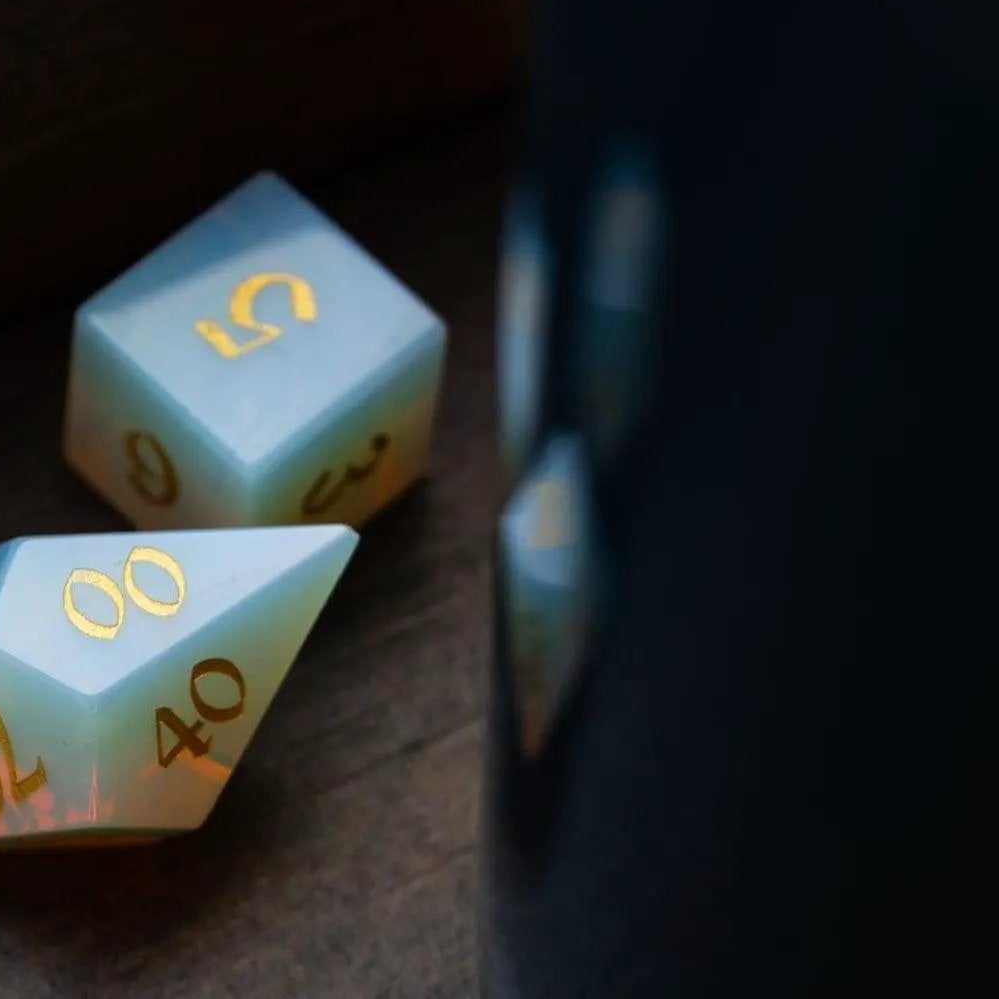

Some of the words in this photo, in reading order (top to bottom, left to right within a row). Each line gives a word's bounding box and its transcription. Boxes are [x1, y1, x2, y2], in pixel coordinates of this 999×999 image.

[194, 272, 319, 360] 5
[62, 545, 187, 641] 00
[153, 657, 246, 768] 40
